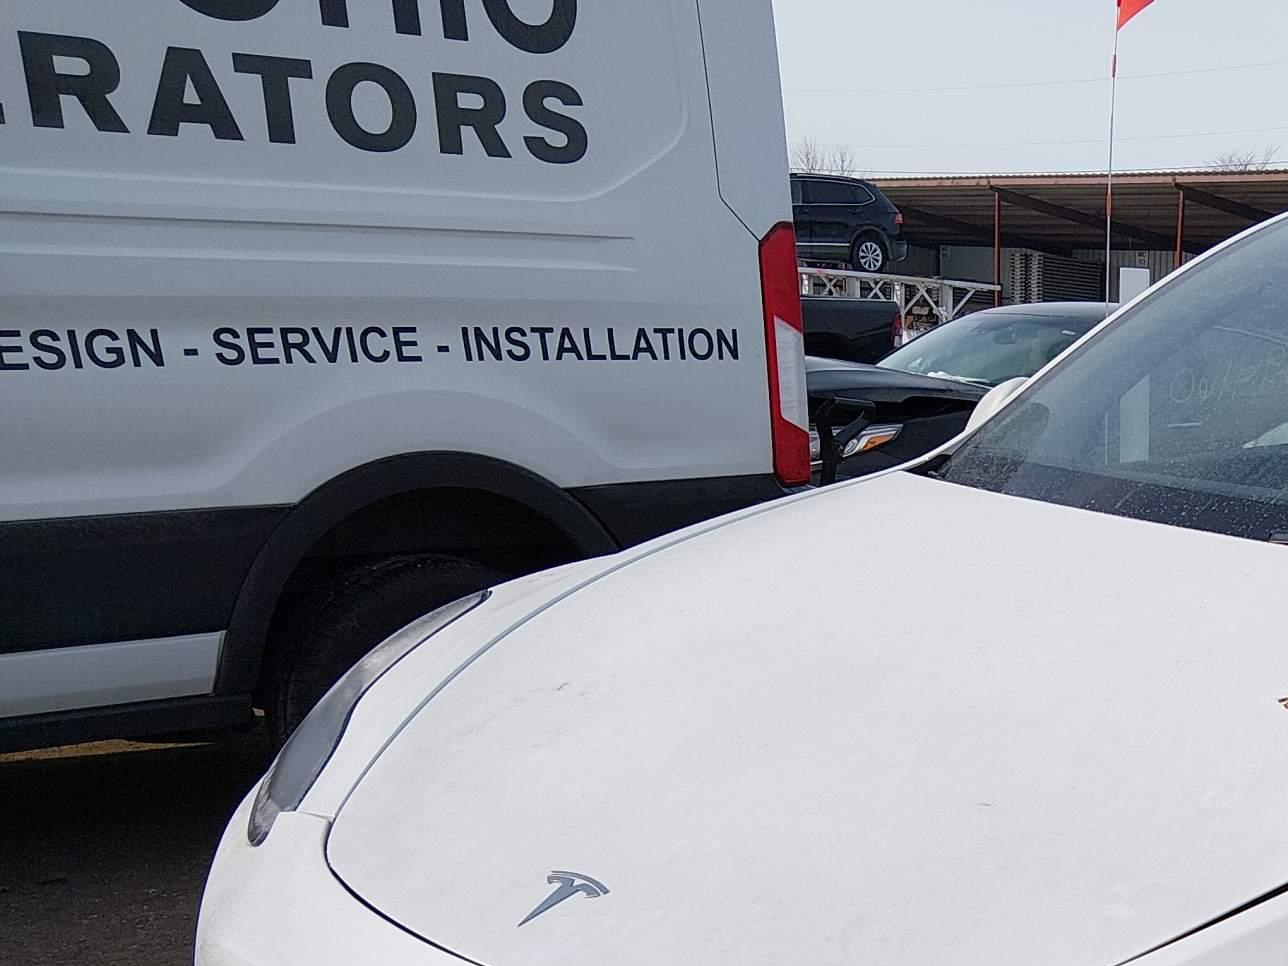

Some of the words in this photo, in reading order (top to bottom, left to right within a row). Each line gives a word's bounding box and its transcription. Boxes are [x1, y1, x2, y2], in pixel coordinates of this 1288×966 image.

[0, 30, 588, 164] RATORS
[212, 326, 423, 366] SERVICE
[461, 326, 739, 362] INSTALLATION
